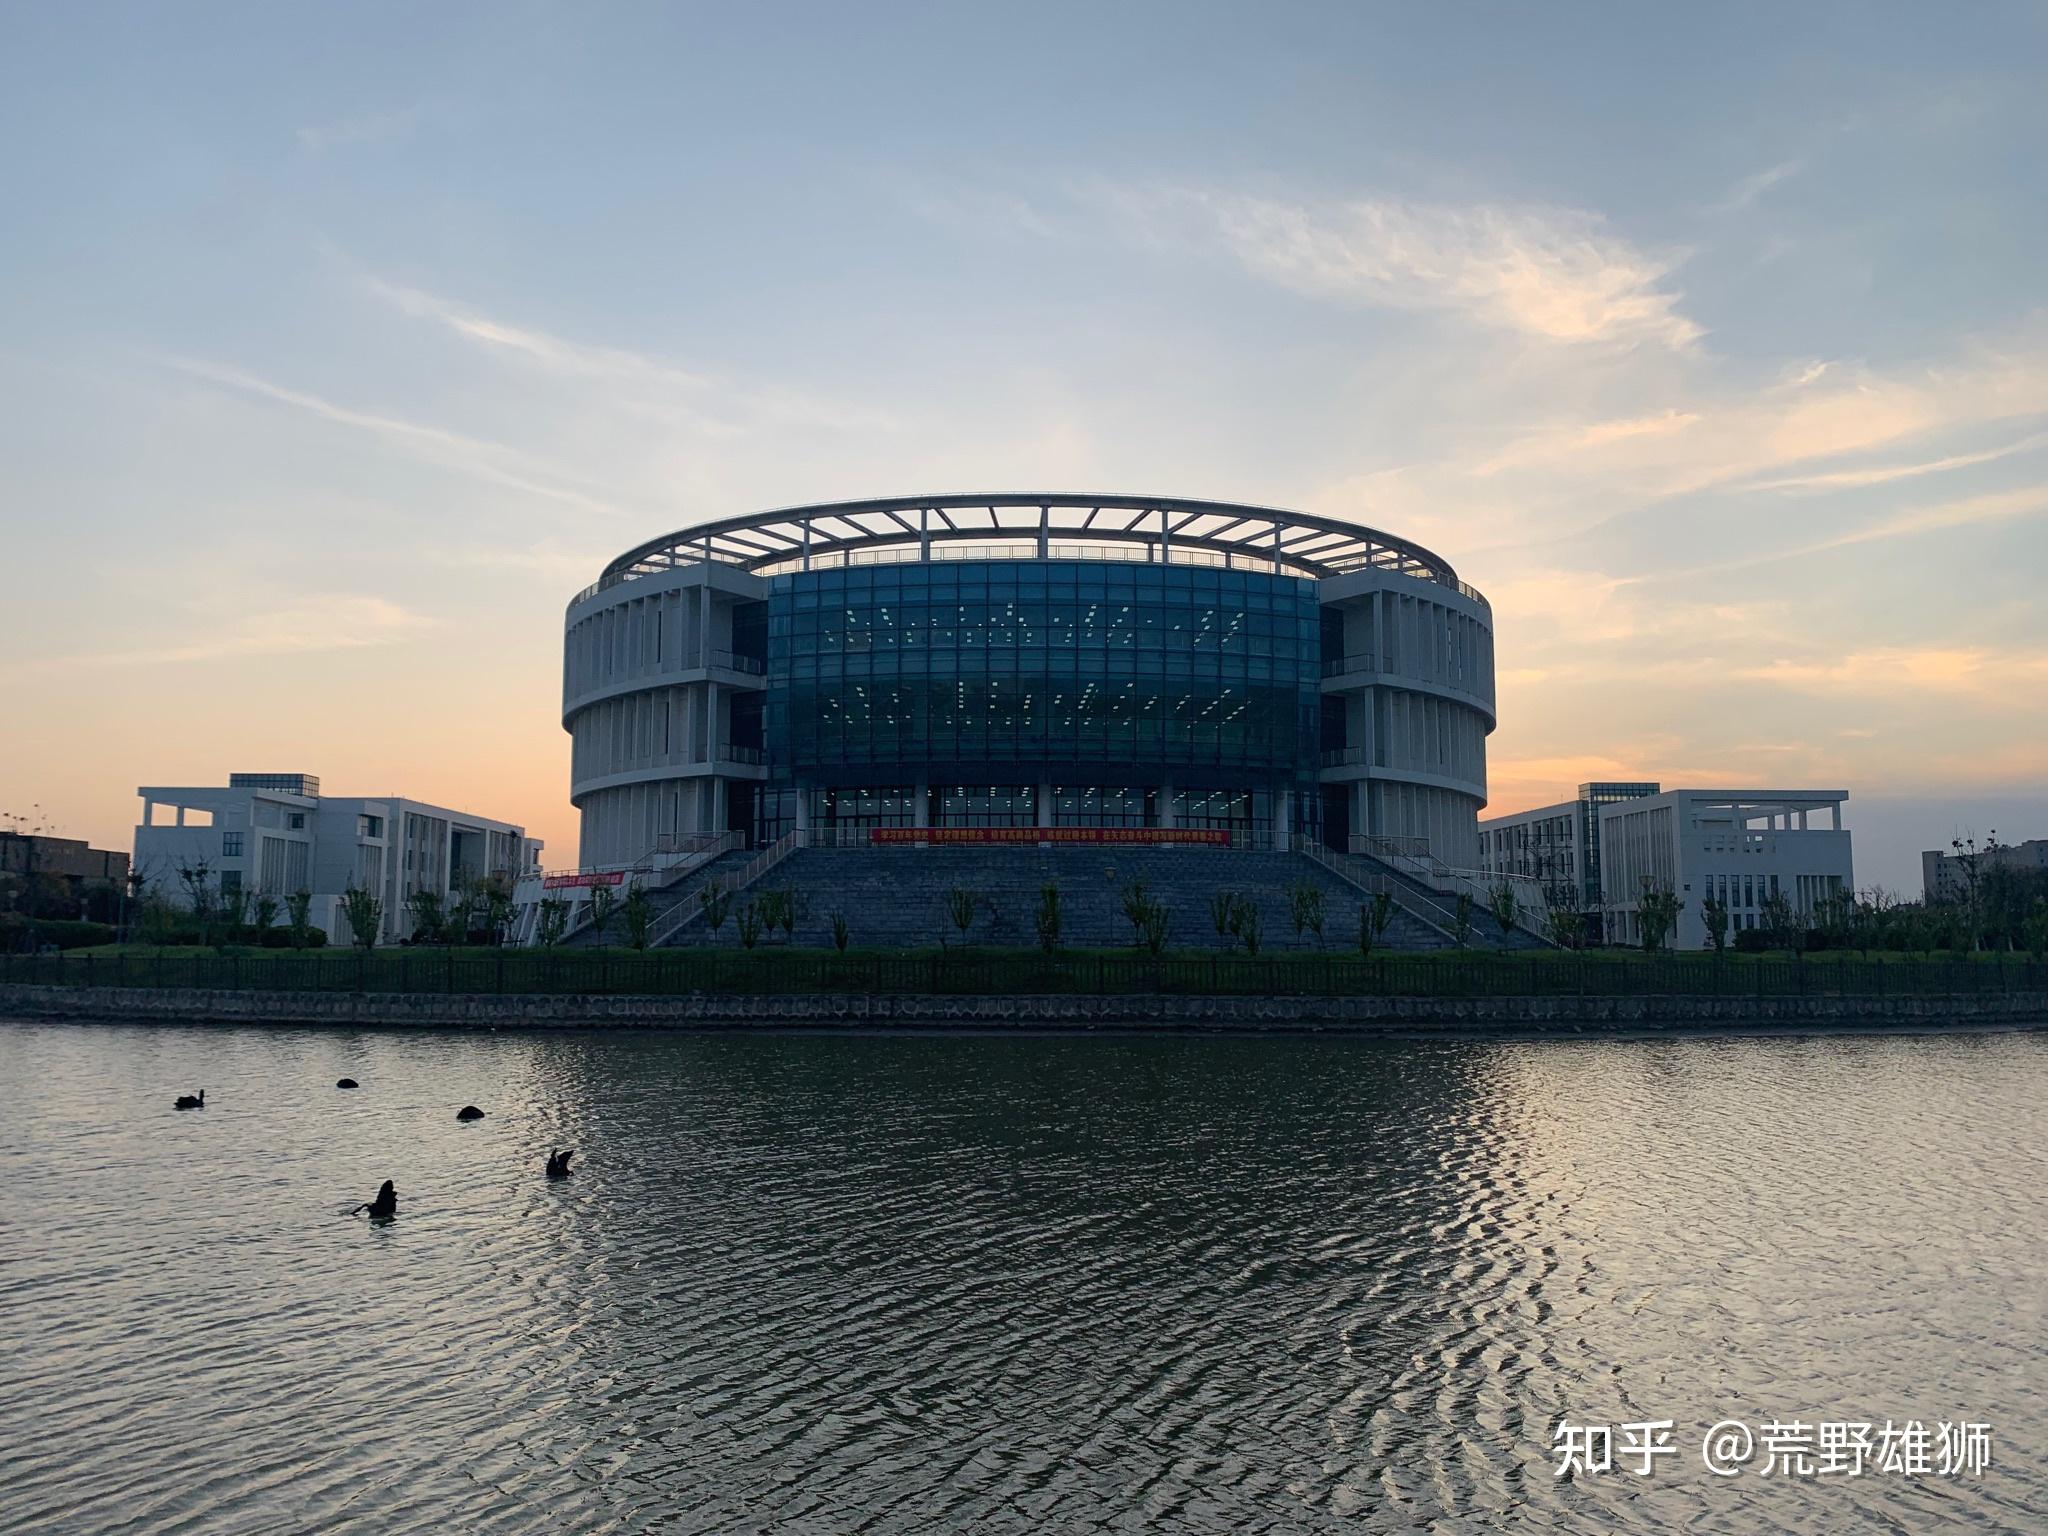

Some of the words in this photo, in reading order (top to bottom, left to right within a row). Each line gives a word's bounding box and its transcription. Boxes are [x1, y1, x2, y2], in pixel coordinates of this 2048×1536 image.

[880, 829, 929, 841] 学习百年党史
